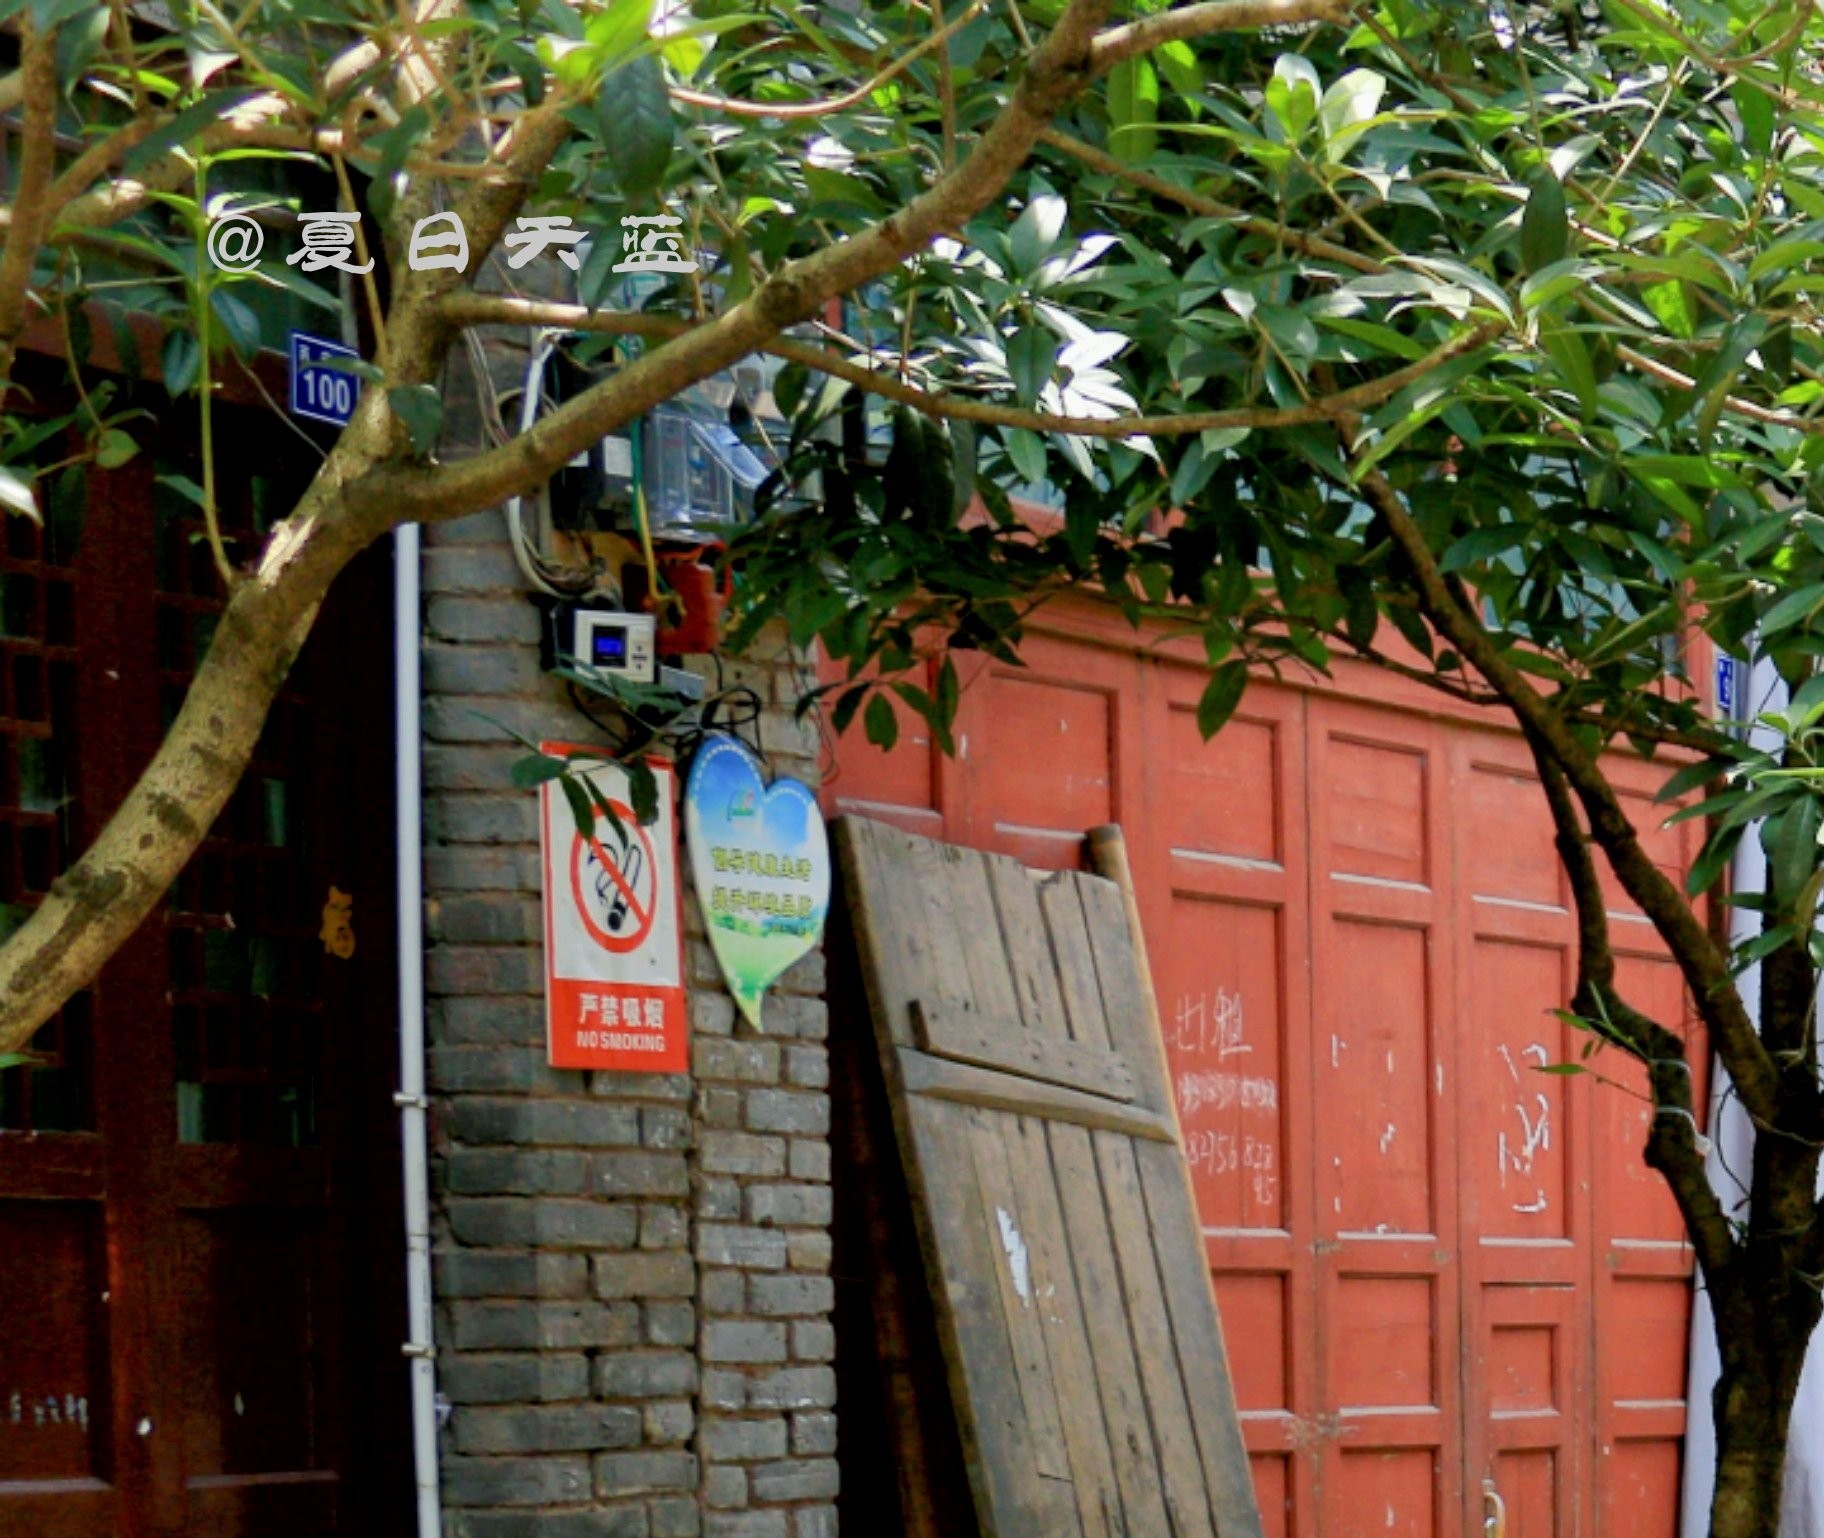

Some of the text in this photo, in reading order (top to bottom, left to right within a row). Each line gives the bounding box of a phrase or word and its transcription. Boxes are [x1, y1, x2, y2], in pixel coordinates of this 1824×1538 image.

[303, 369, 350, 414] 100
[579, 992, 665, 1029] 严禁吸烟
[1176, 986, 1253, 1063] 出租
[577, 1030, 666, 1052] NO SMOKING
